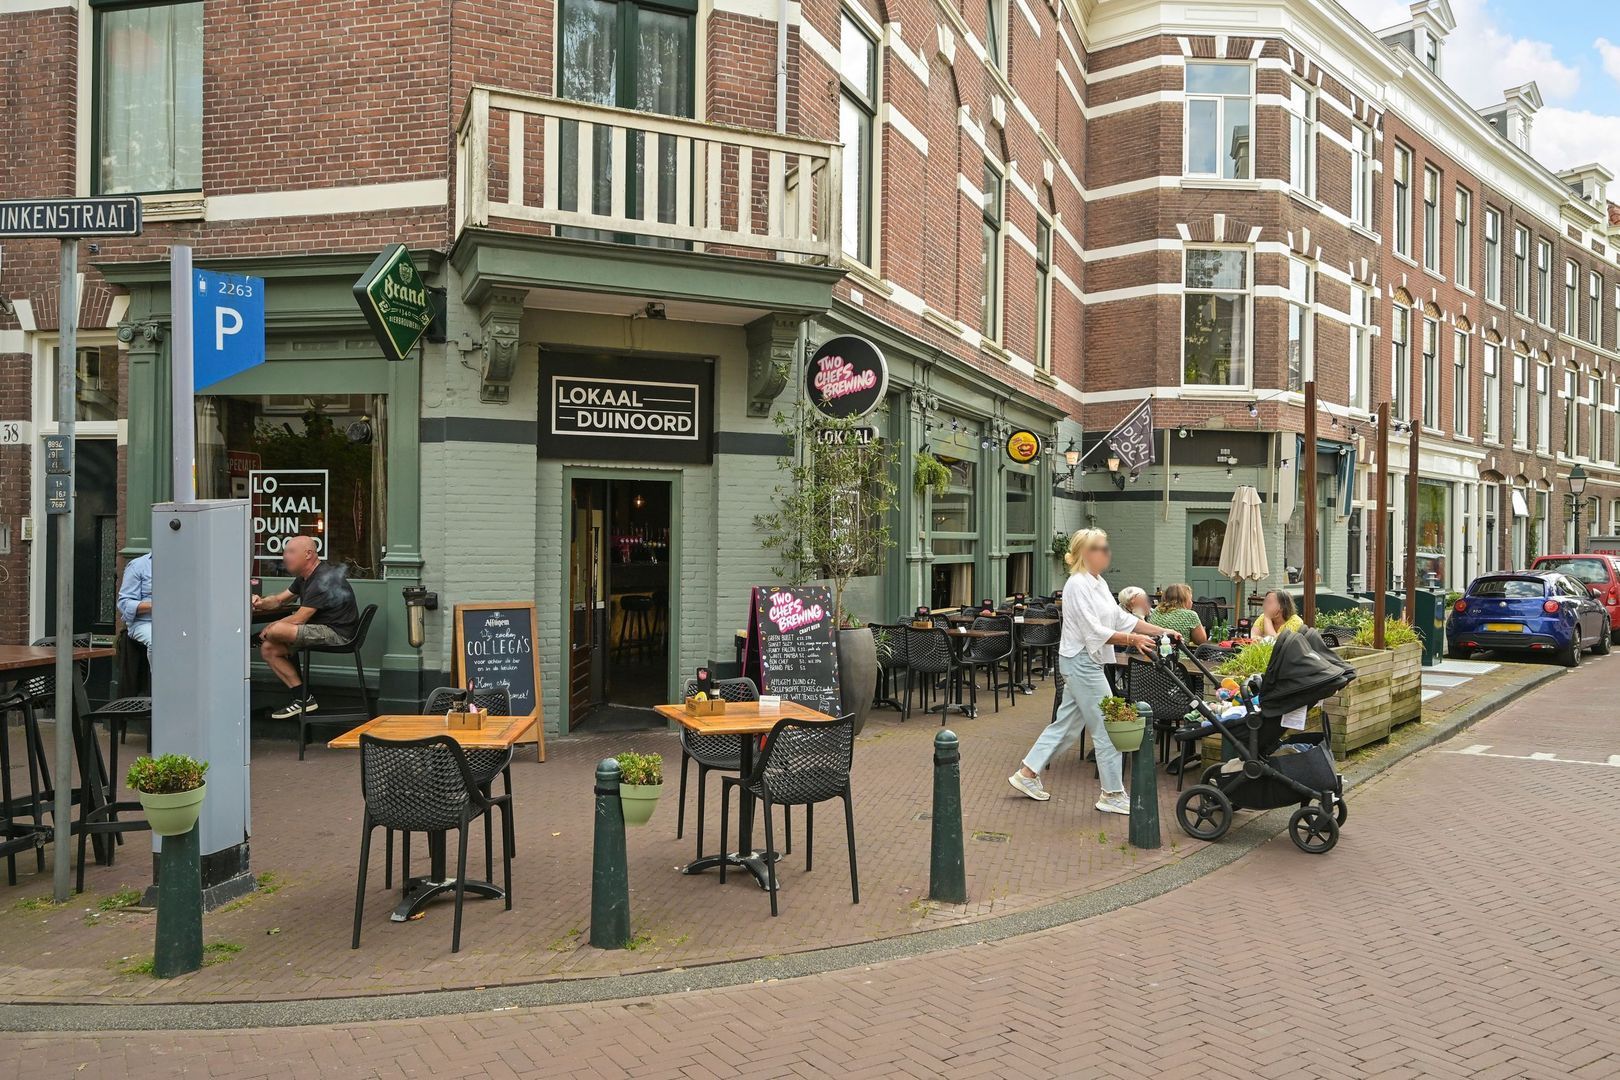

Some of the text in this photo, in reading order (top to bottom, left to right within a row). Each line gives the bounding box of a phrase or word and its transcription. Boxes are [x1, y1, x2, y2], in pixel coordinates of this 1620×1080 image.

[218, 281, 252, 297] 2263
[384, 274, 426, 307] Brand
[215, 306, 243, 350] P
[817, 355, 843, 371] TWO
[815, 363, 854, 389] CHEFS
[822, 369, 877, 399] BREWING
[559, 386, 643, 407] LOKAAL
[577, 411, 692, 432] DUINOORD
[3, 424, 19, 442] 38
[253, 477, 278, 494] LO
[272, 497, 321, 513] KAAL
[253, 517, 299, 534] DUIN
[769, 592, 792, 606] TWO
[769, 599, 802, 621] CHEFS
[777, 604, 824, 633] BREWING
[467, 636, 530, 656] COLLEGA'S
